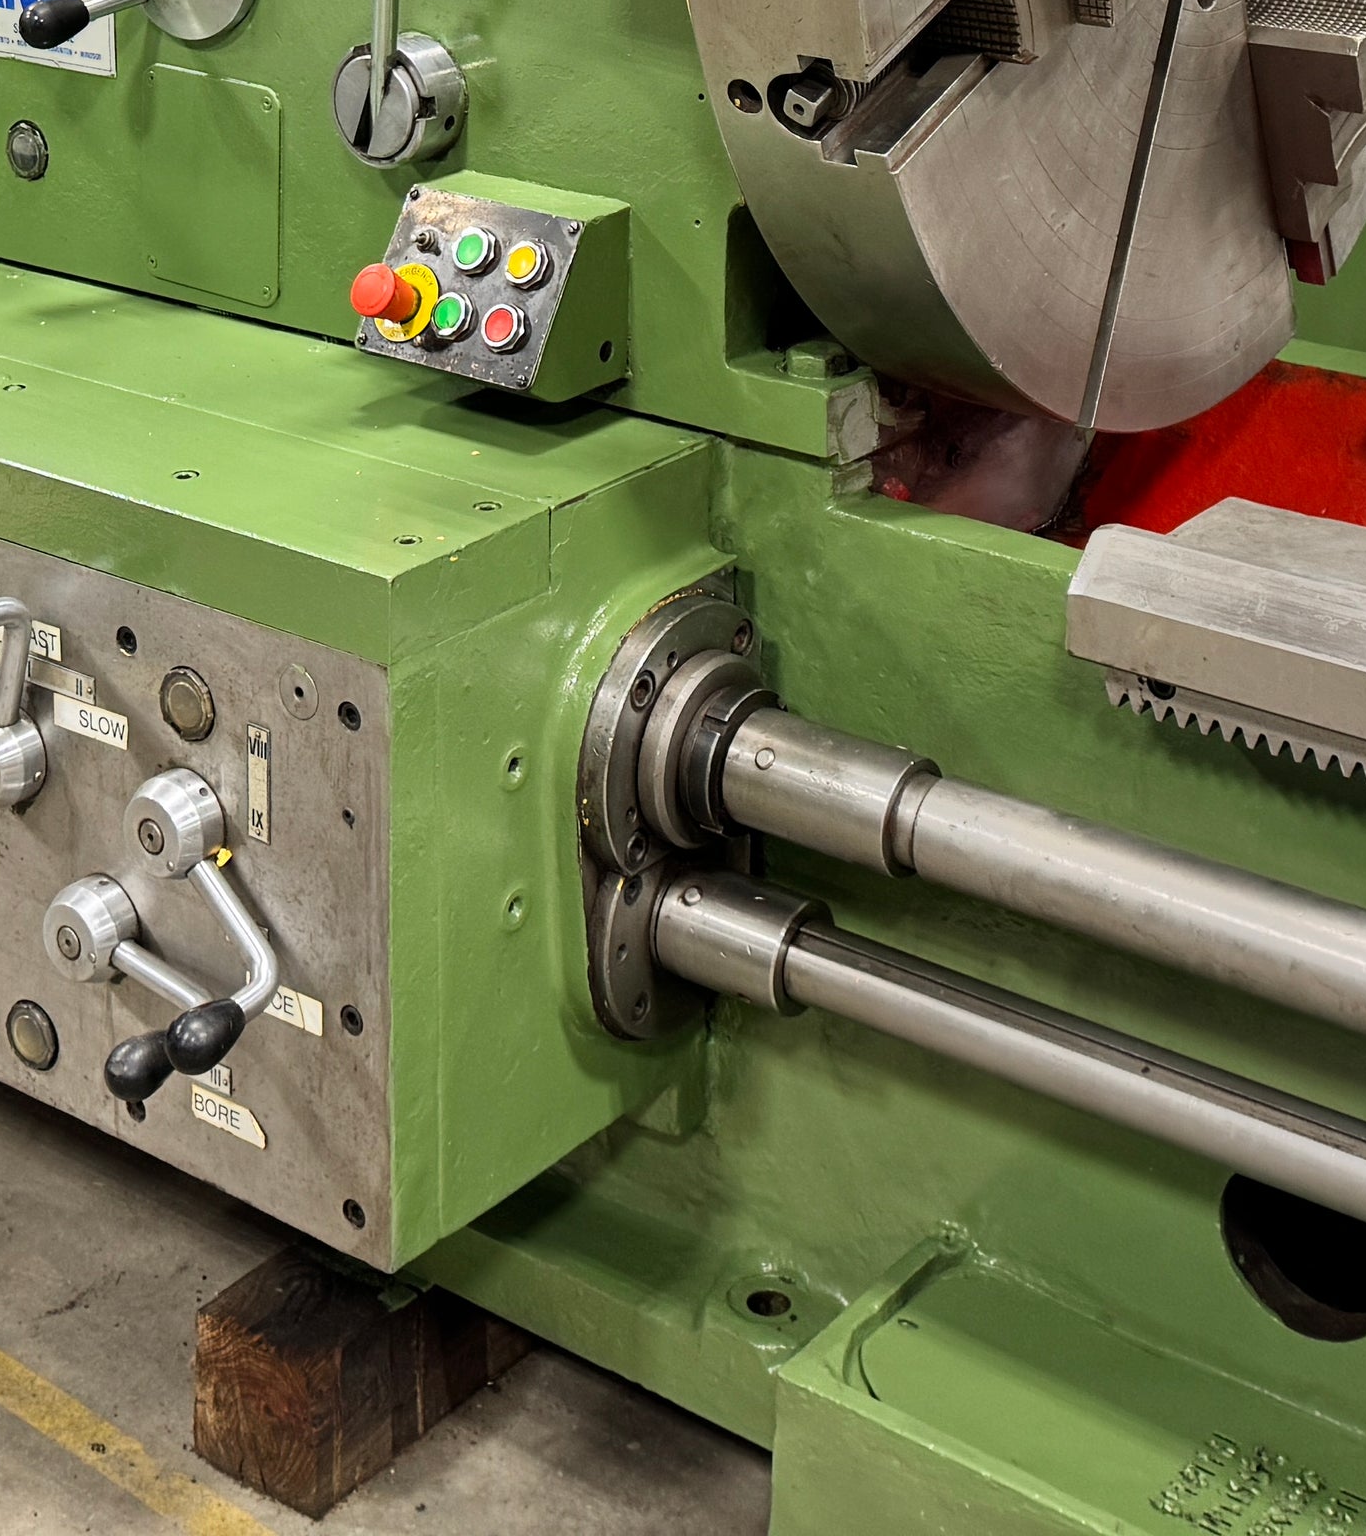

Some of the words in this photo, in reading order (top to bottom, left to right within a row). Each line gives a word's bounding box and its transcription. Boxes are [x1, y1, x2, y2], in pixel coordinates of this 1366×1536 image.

[399, 267, 434, 287] ERGENCY
[31, 627, 57, 652] AST
[79, 709, 126, 741] SLOW
[248, 736, 267, 760] VIII
[251, 808, 264, 831] IX
[194, 1092, 241, 1131] BORE
